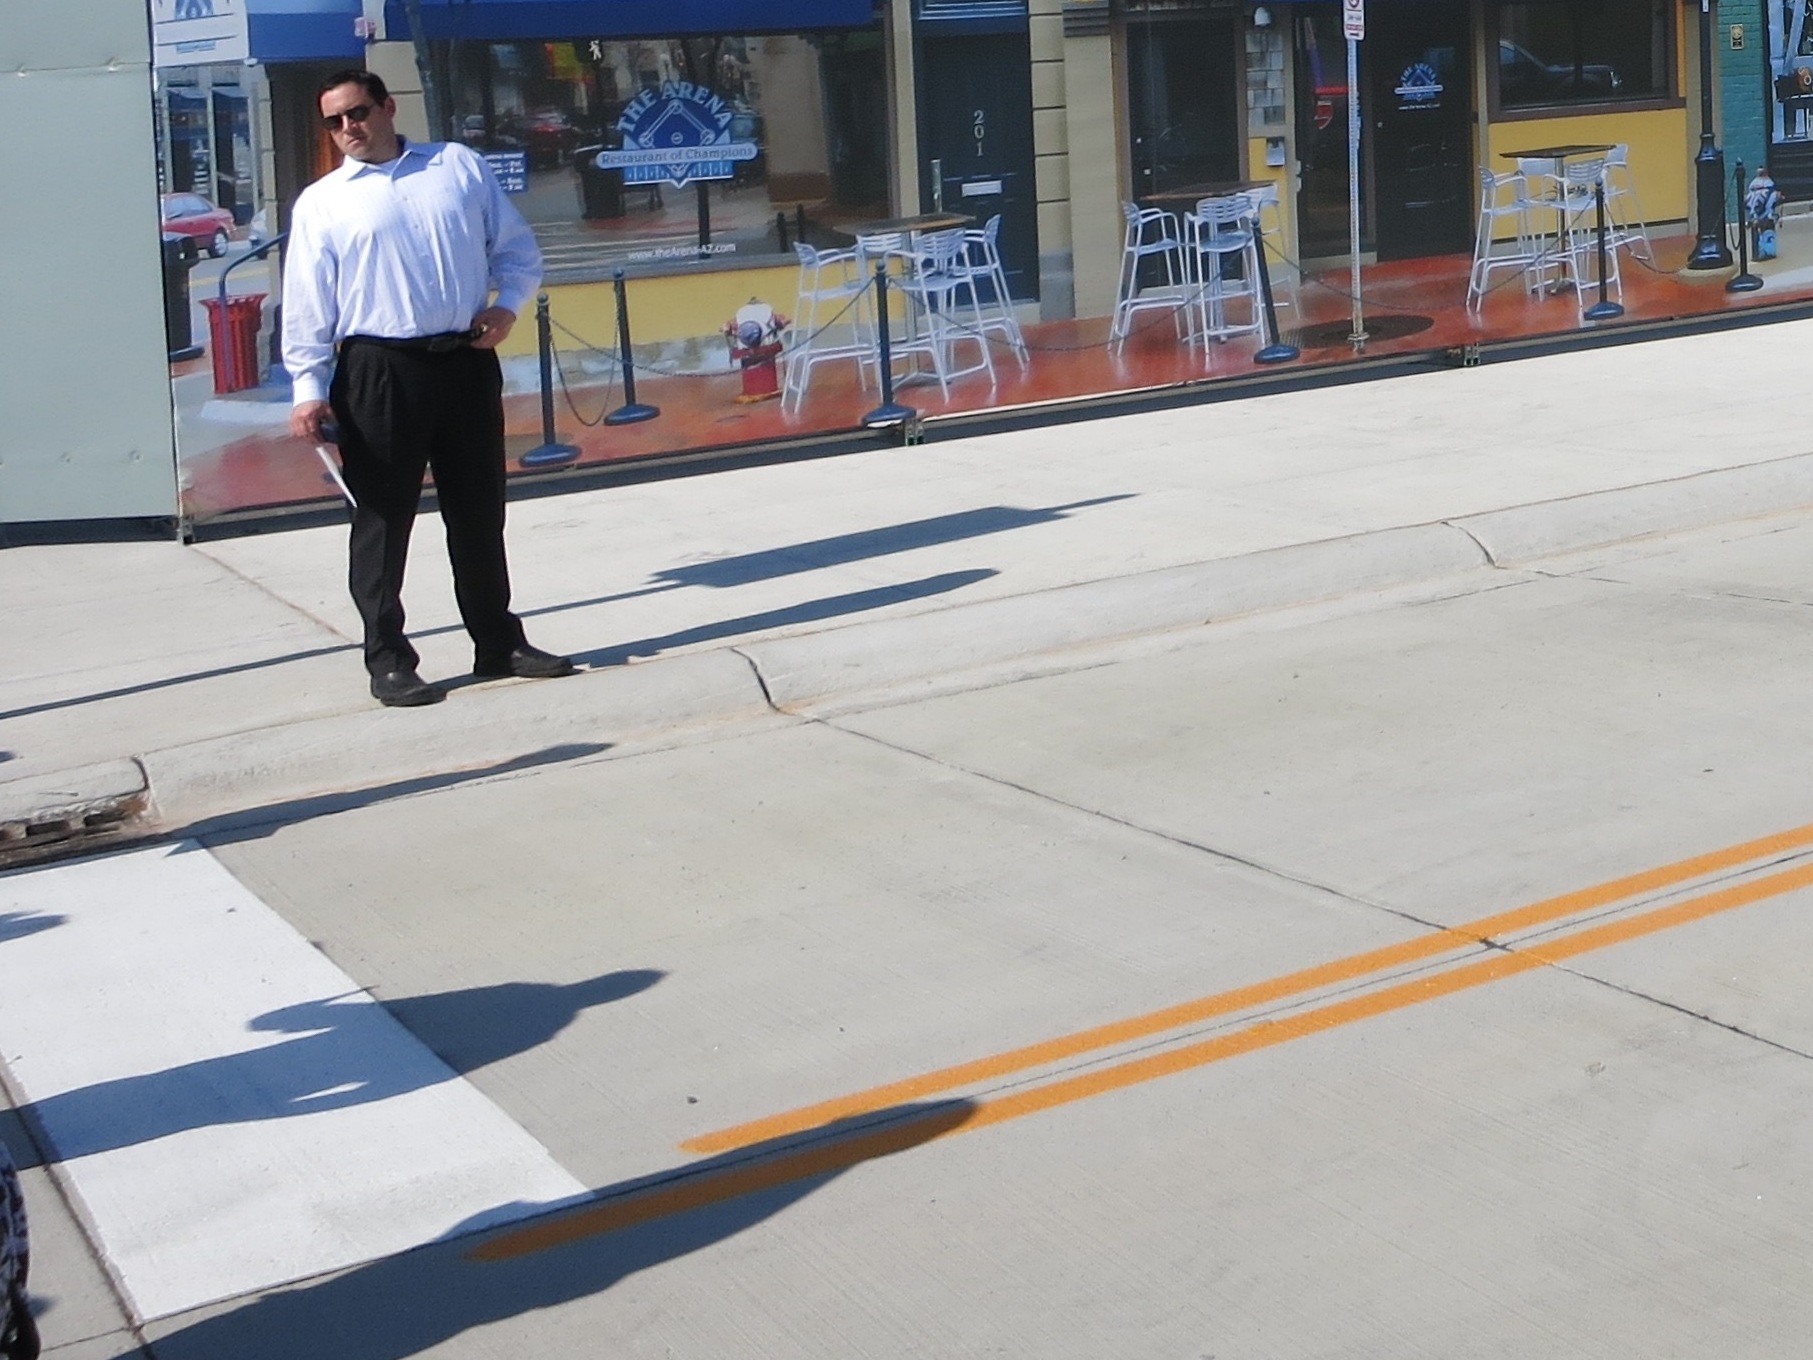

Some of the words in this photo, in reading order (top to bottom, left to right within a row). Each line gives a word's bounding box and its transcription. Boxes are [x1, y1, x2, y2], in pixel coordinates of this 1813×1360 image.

[616, 88, 657, 133] THE
[661, 80, 733, 128] ARENA
[601, 151, 668, 166] Restaurant
[670, 149, 683, 163] of
[685, 143, 753, 162] Champions
[973, 109, 985, 157] 201
